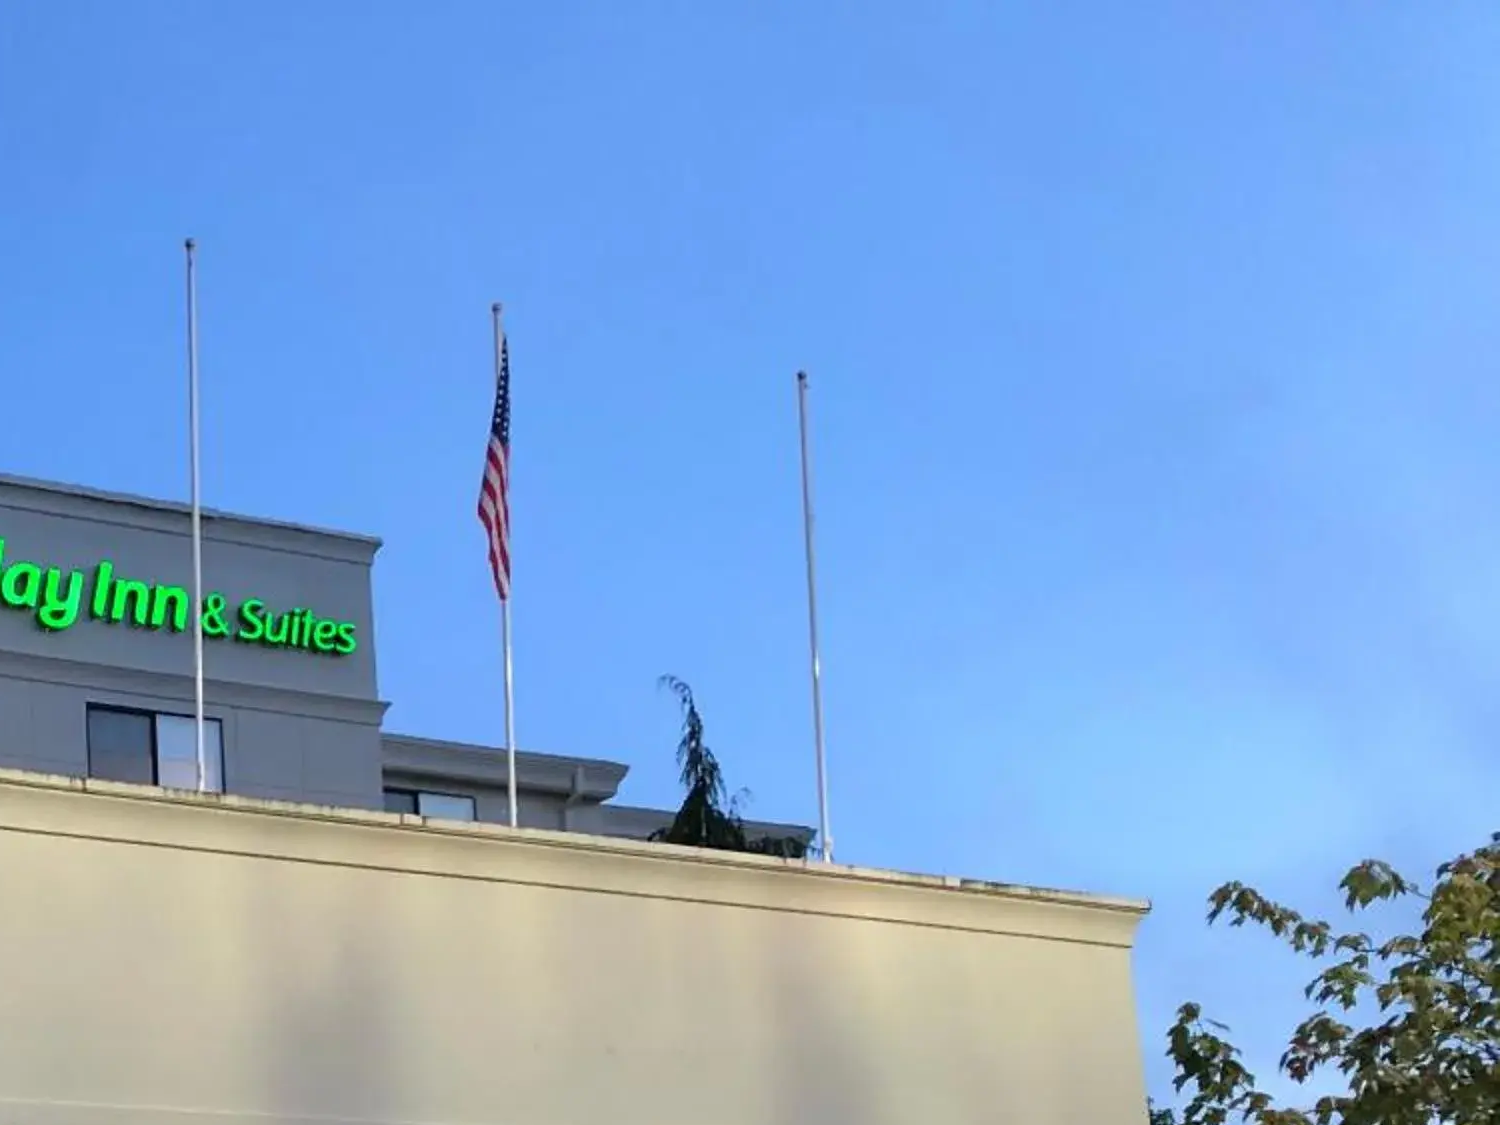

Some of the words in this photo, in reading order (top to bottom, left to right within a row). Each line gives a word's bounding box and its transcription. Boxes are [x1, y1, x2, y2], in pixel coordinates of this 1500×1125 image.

[92, 560, 189, 632] Inn
[201, 592, 229, 637] &
[238, 599, 357, 654] Suites
